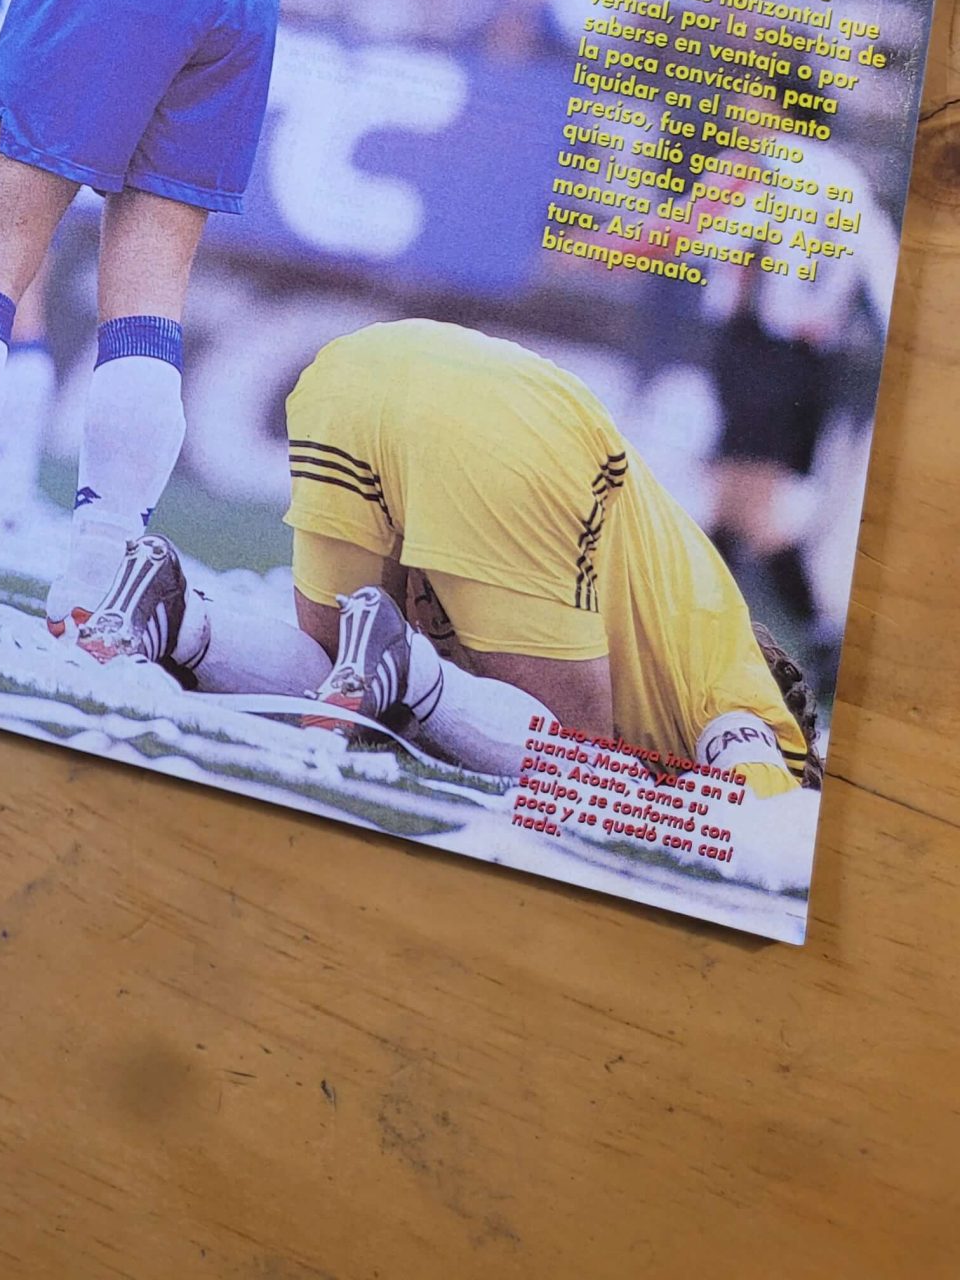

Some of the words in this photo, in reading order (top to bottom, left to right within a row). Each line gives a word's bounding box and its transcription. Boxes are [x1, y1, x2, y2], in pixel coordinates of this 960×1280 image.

[584, 15, 670, 50] saberse
[673, 35, 703, 57] en
[708, 42, 793, 80] ventaja
[795, 64, 814, 82] o
[816, 68, 859, 90] por
[837, 17, 881, 41] que
[573, 62, 661, 102] liquidar
[663, 90, 693, 111] en
[697, 92, 723, 117] el
[723, 103, 832, 143] momento
[577, 36, 601, 62] la
[604, 48, 661, 76] poca
[662, 61, 779, 104] convicción
[779, 87, 839, 116] para
[563, 124, 625, 151] quien
[631, 138, 686, 166] salió
[688, 152, 820, 196] ganancioso
[824, 183, 855, 204] en
[566, 97, 652, 130] preciso,
[659, 110, 698, 141] fue
[700, 120, 805, 164] Palestino
[547, 203, 601, 232] tura.
[606, 215, 643, 242] Así
[647, 226, 673, 250] ni
[672, 234, 758, 269] pensar
[759, 255, 790, 276] en
[795, 259, 818, 282] el
[553, 178, 651, 215] monarca
[656, 197, 694, 225] del
[696, 211, 784, 246] pasado
[788, 228, 853, 258] Aper-
[542, 226, 708, 287] bicampeonato.
[527, 736, 587, 763] cuando
[594, 750, 649, 780] Morón
[655, 771, 694, 792] yace
[702, 783, 720, 798] en
[728, 788, 744, 804] el
[530, 713, 544, 731] El
[550, 719, 588, 744] Beto
[589, 733, 661, 763] reclama
[664, 749, 745, 786] inocencia
[519, 774, 580, 806] equipo,
[590, 793, 606, 808] se
[614, 800, 695, 832] conformó
[702, 824, 729, 841] con
[521, 754, 560, 776] piso.
[569, 764, 628, 799] Acosta,
[638, 787, 682, 809] como
[689, 800, 707, 815] su
[513, 813, 560, 836] nada.
[514, 793, 555, 814] poco
[562, 805, 573, 823] y
[579, 810, 595, 825] se
[603, 817, 656, 841] quedó
[663, 833, 691, 851] con
[699, 843, 732, 862] casi
